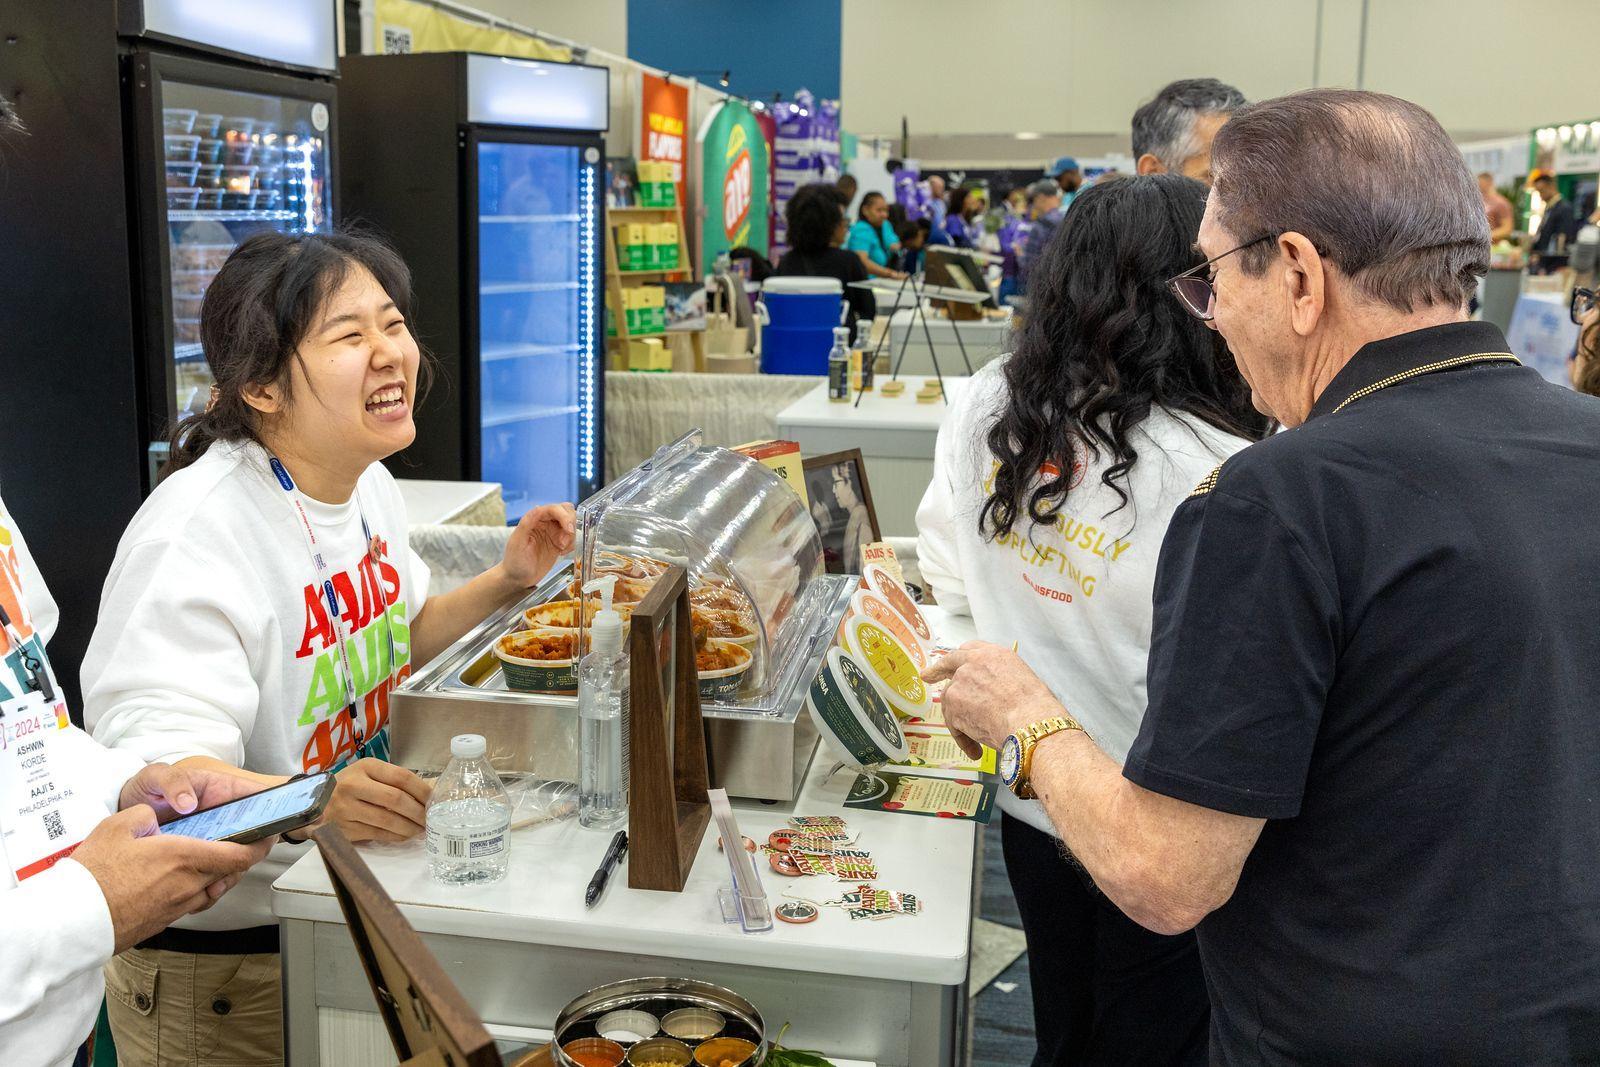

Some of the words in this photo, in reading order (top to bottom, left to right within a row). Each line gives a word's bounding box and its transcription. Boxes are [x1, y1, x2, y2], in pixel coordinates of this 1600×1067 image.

[15, 716, 41, 738] 2024
[17, 740, 45, 757] ASHWIN
[20, 753, 47, 770] KORDE
